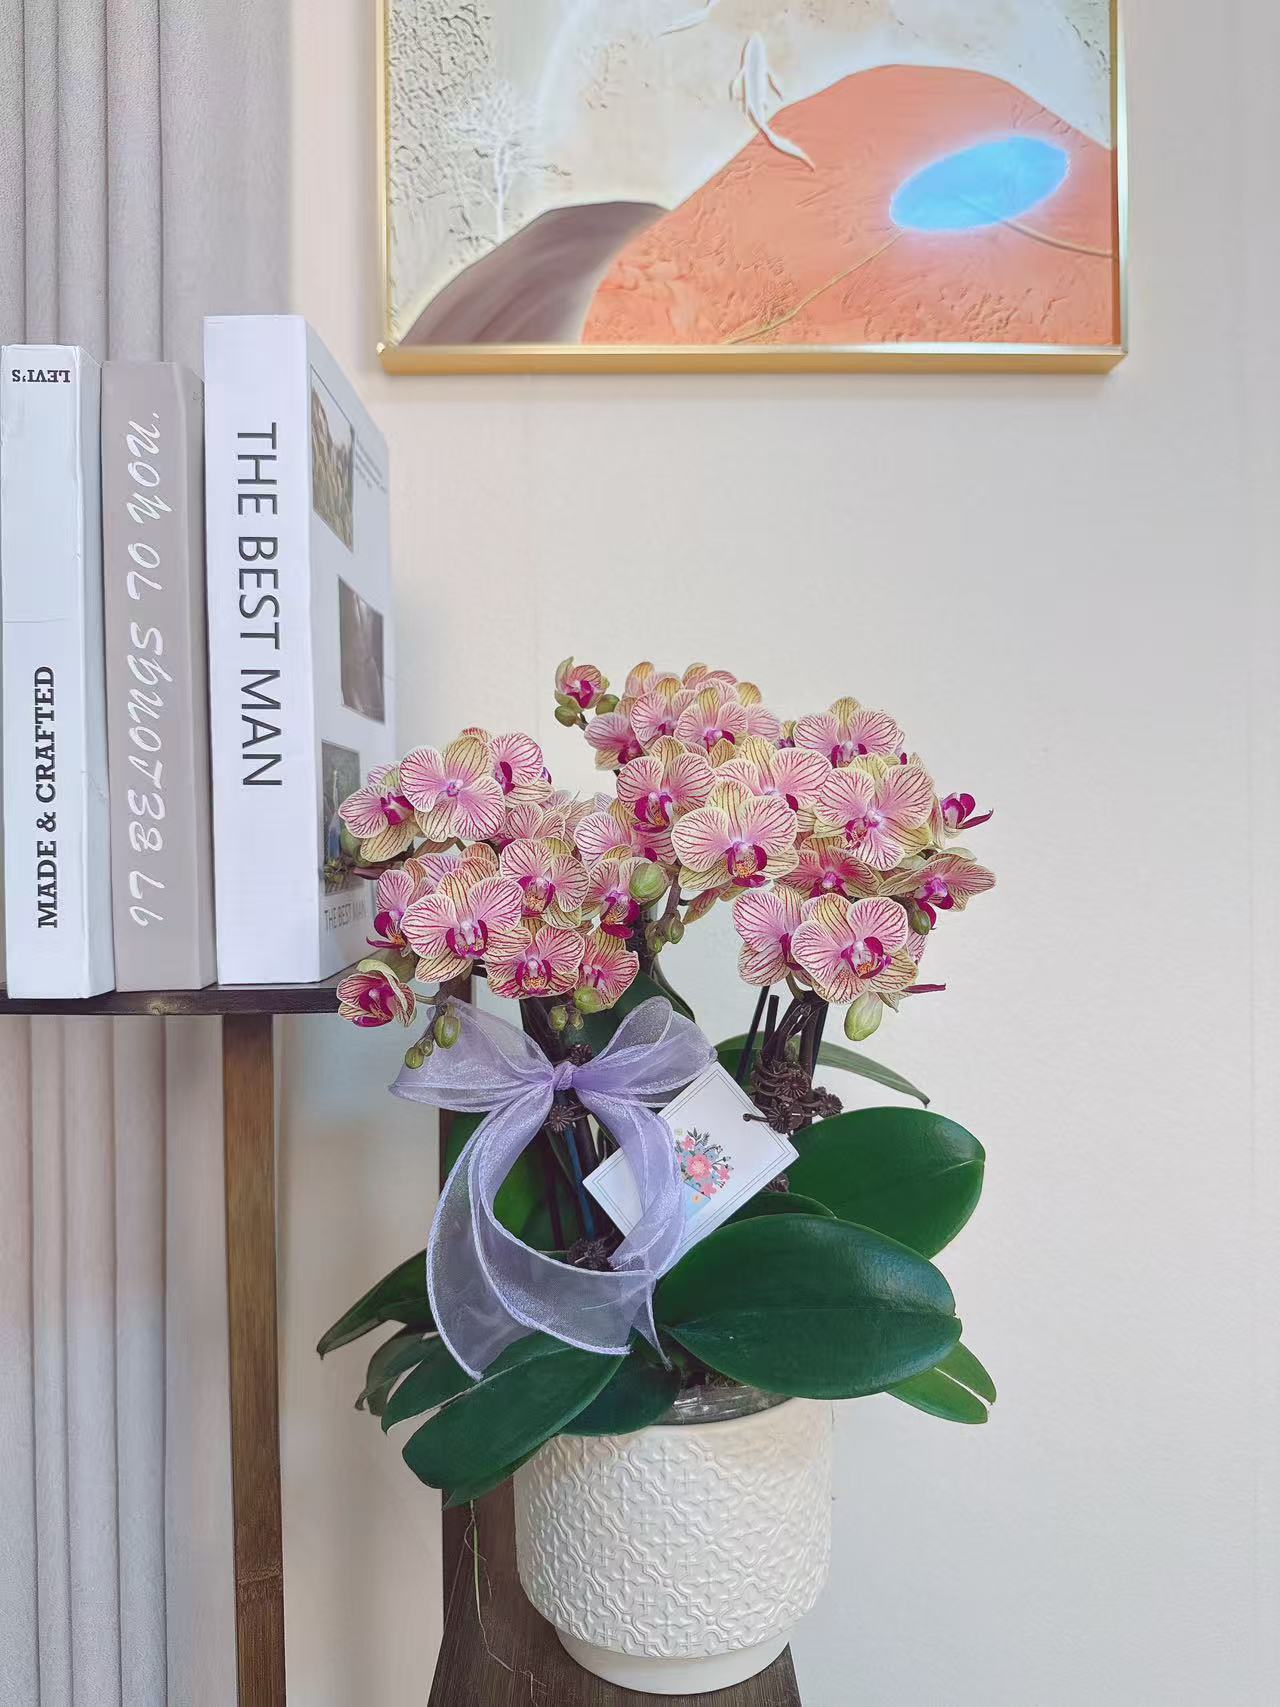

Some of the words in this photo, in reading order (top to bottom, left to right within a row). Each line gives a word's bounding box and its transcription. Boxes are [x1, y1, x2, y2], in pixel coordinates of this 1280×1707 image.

[11, 369, 71, 383] LEVI'S
[127, 412, 173, 524] YOU.
[237, 421, 279, 516] THE
[126, 542, 163, 601] TO
[238, 536, 281, 651] BEST
[34, 666, 56, 802] CRAFTED
[127, 622, 172, 852] BELONGS
[240, 669, 283, 786] MAN
[36, 811, 57, 833] &
[36, 840, 58, 929] MADE
[129, 870, 166, 927] IT
[323, 907, 337, 930] THE
